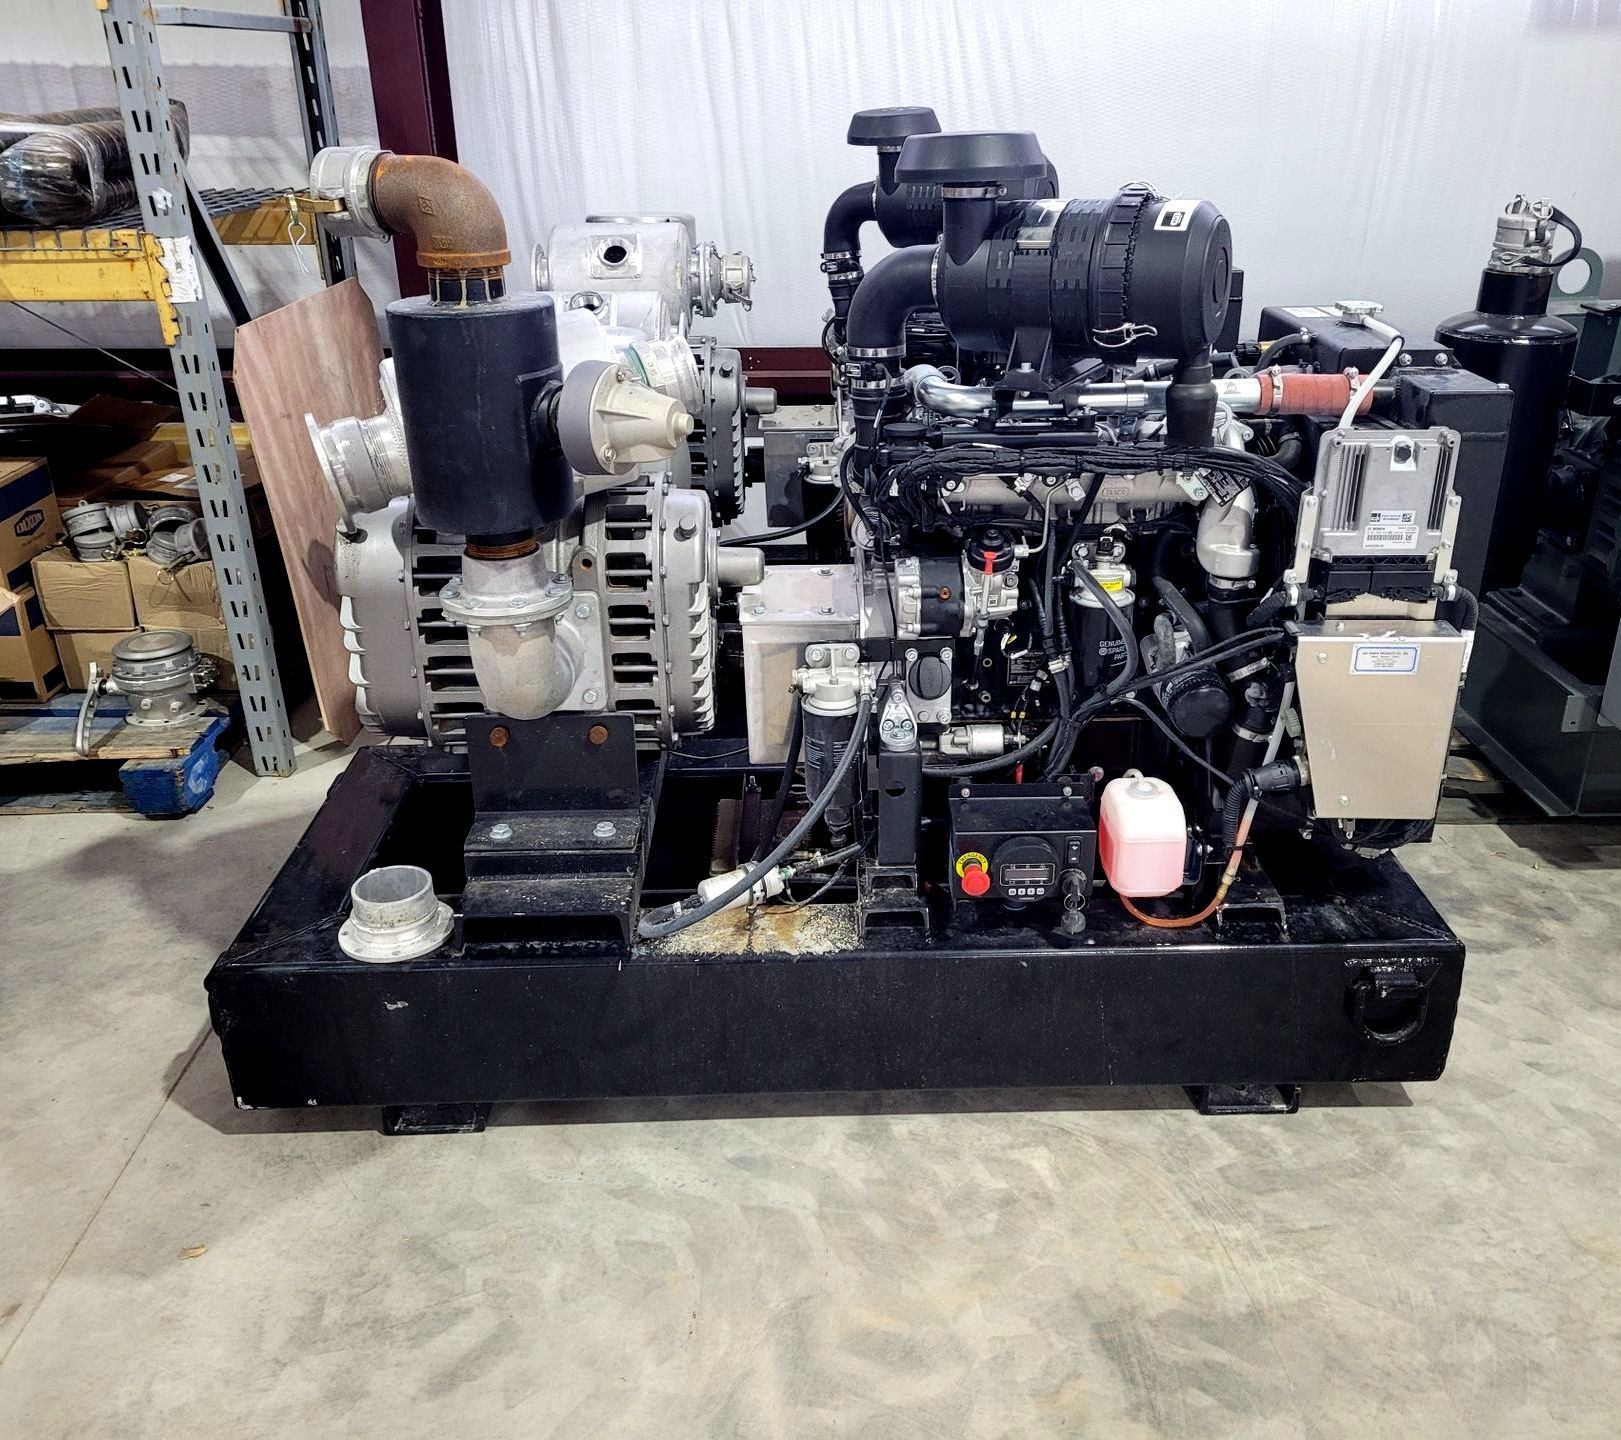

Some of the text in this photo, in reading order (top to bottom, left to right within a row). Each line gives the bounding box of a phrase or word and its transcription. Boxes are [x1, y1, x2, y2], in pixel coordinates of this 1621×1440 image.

[16, 512, 43, 534] DIXON
[1099, 640, 1126, 648] GENUIN
[957, 852, 987, 865] EMERGENCY
